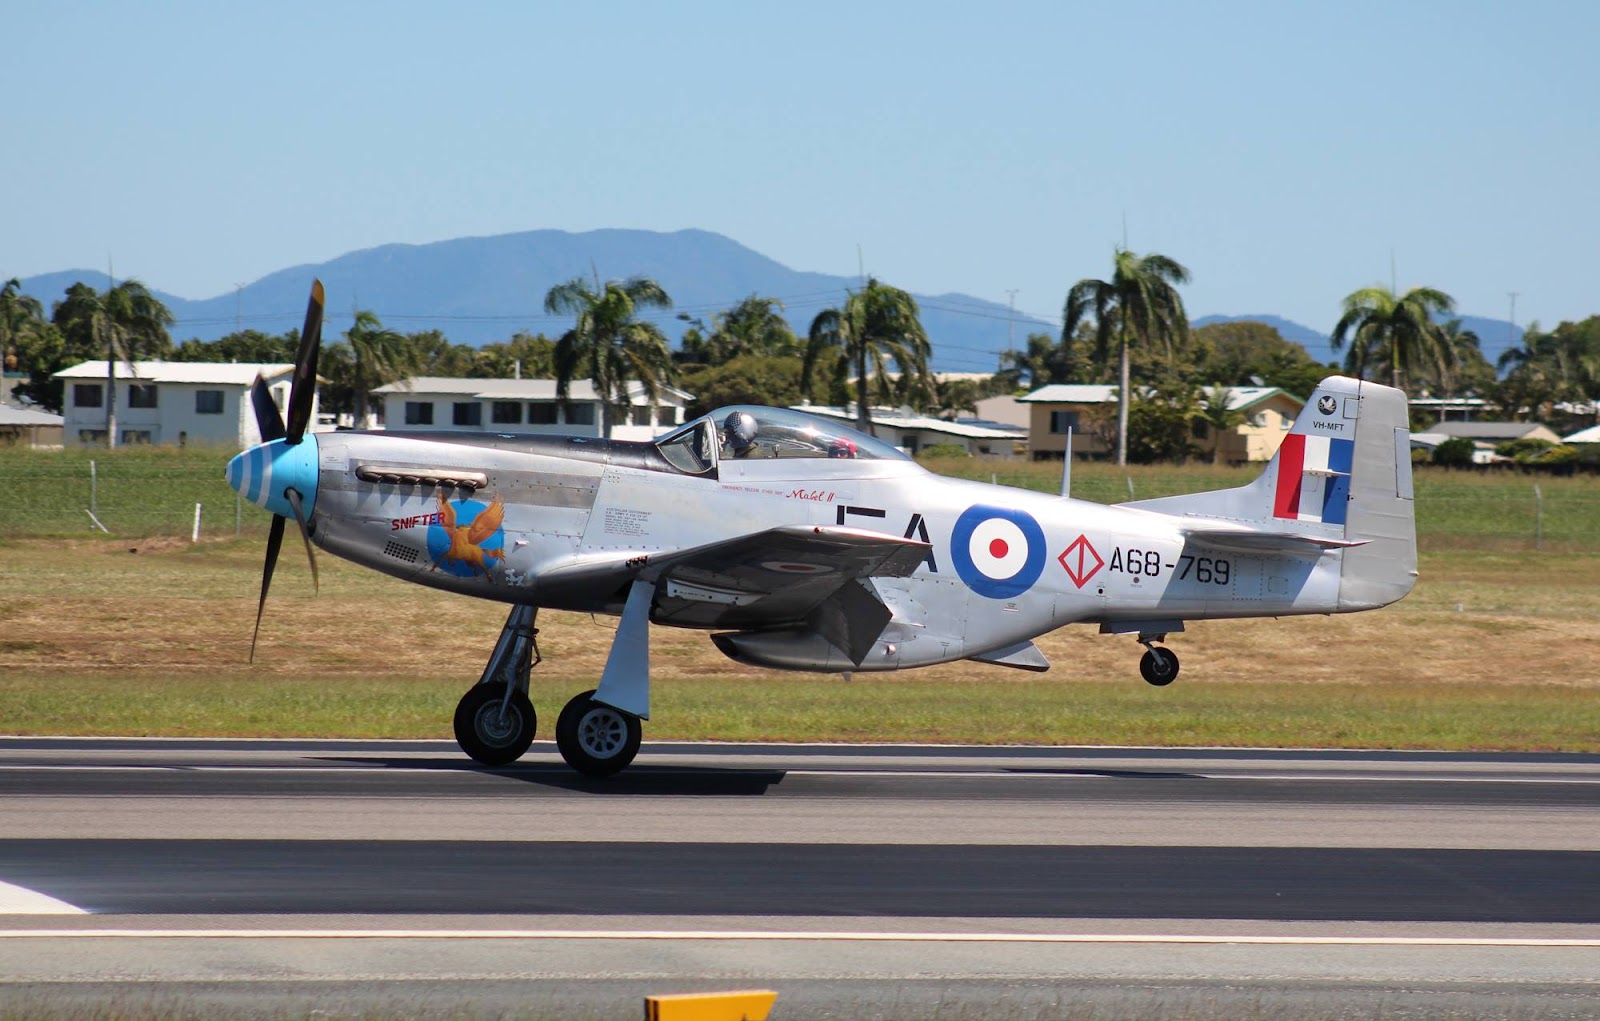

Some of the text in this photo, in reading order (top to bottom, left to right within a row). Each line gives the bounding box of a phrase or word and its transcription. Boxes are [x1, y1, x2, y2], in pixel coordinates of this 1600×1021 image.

[1313, 420, 1344, 431] VH-MFT
[786, 489, 825, 502] Mabel
[391, 511, 446, 531] SNIFTER
[1109, 546, 1230, 586] A68-769
